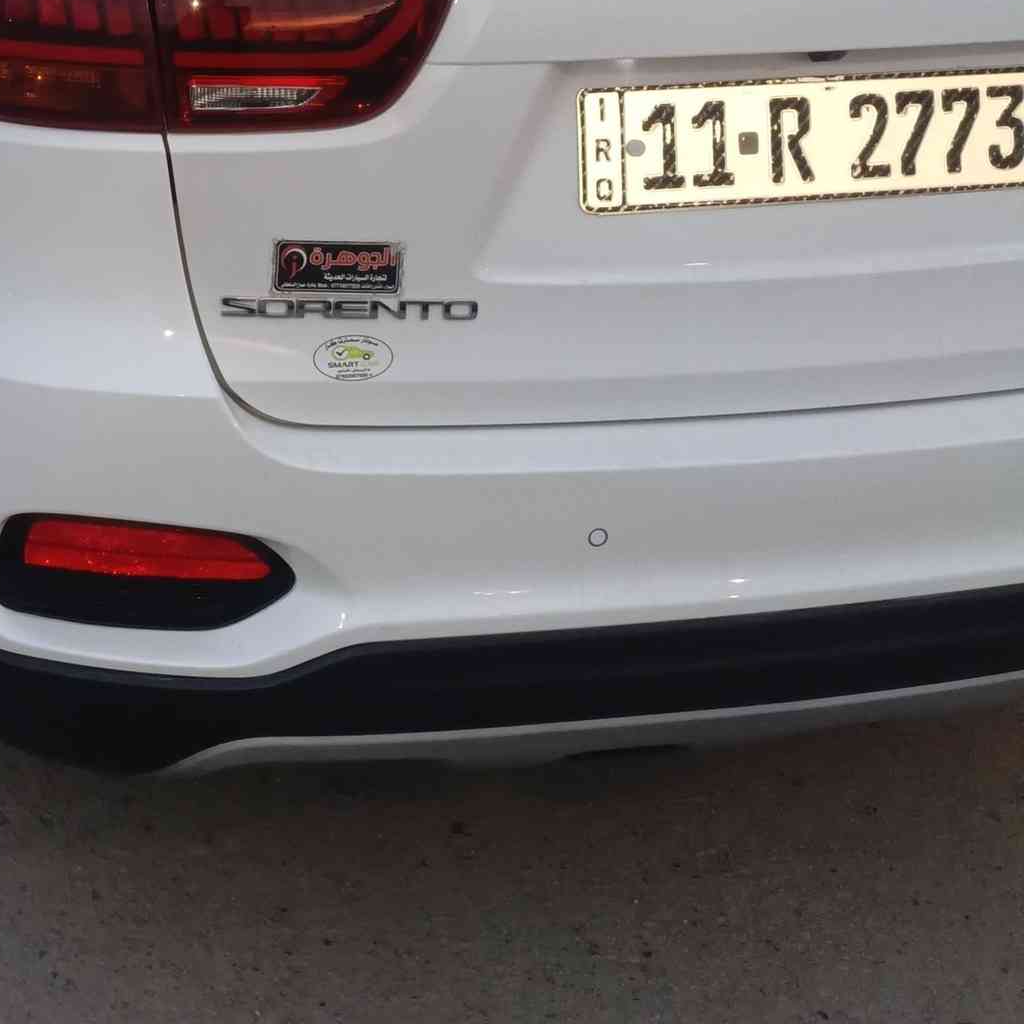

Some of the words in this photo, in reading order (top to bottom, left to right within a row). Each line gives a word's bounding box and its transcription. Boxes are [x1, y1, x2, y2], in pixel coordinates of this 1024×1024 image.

[641, 100, 736, 190] 11
[768, 96, 816, 184] R
[309, 247, 399, 271] الجوهرة
[221, 297, 479, 321] SORENTO
